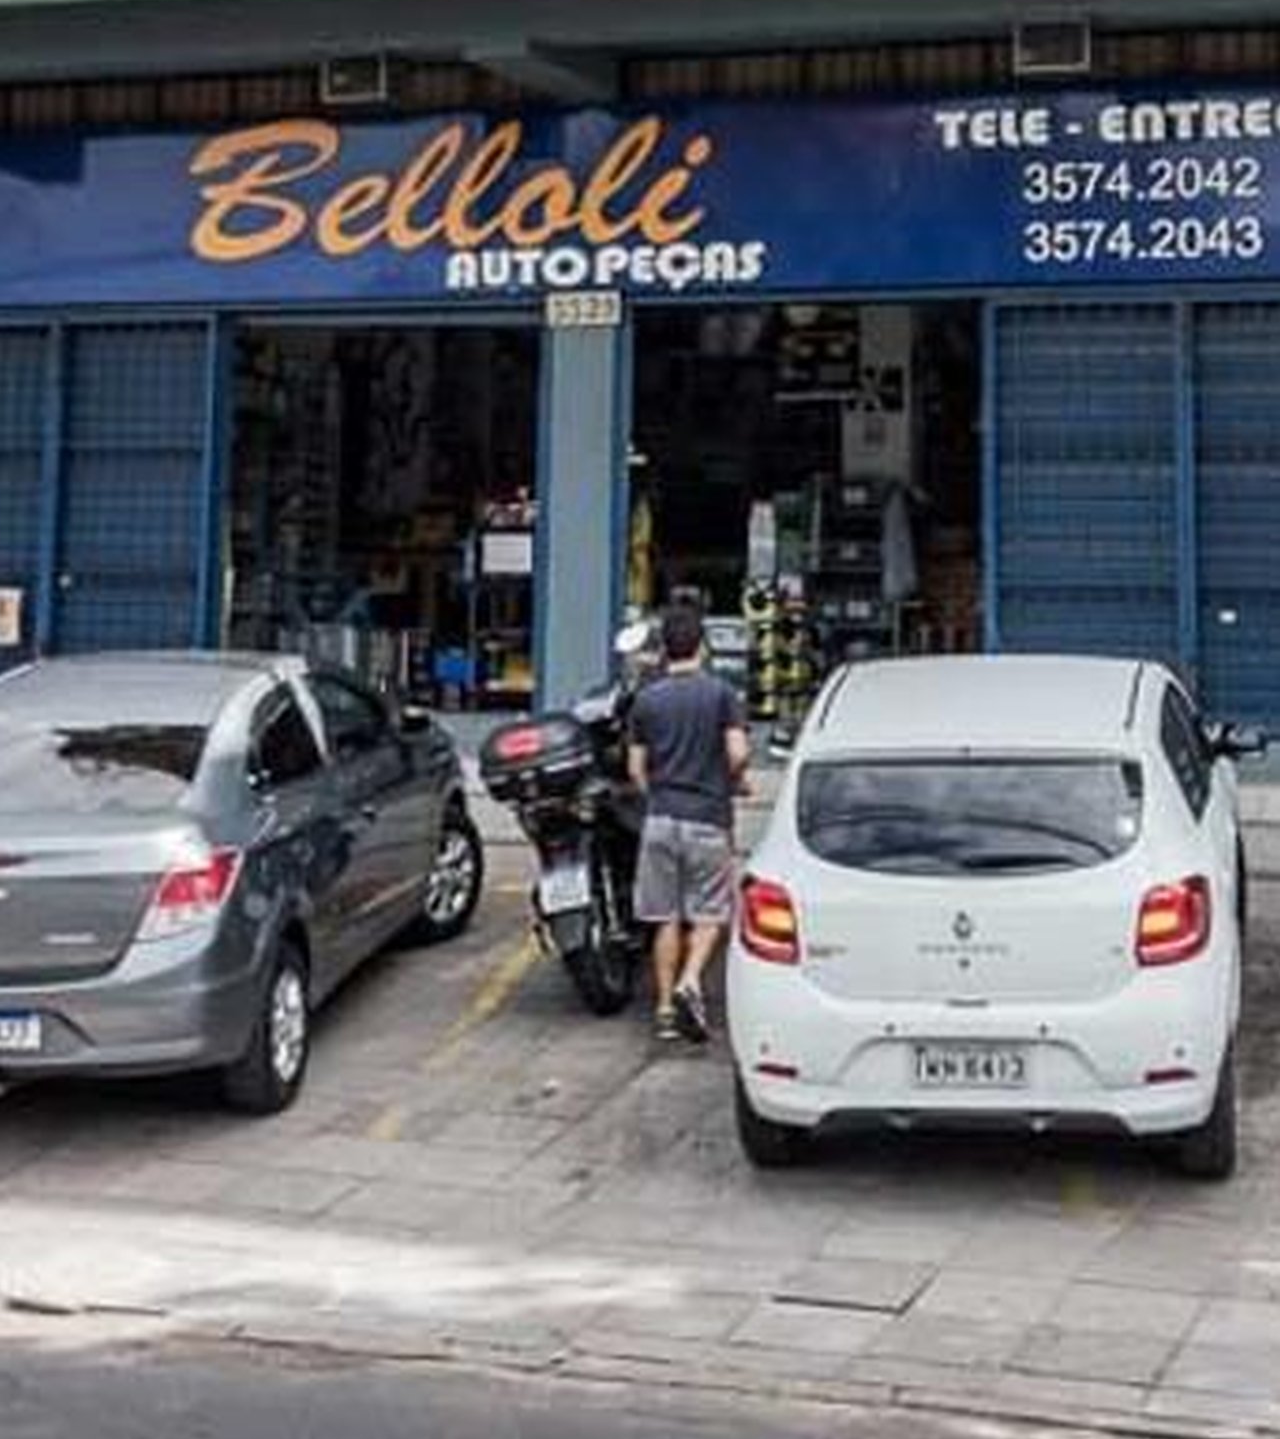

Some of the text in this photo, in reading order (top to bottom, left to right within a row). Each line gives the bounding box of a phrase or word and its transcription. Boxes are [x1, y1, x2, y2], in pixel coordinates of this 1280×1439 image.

[934, 108, 1051, 150] TELE
[187, 115, 713, 262] Belloli
[1023, 157, 1262, 204] 3574.2042
[1023, 216, 1264, 263] 3574.2043
[445, 240, 768, 290] AUTO PEÇAS
